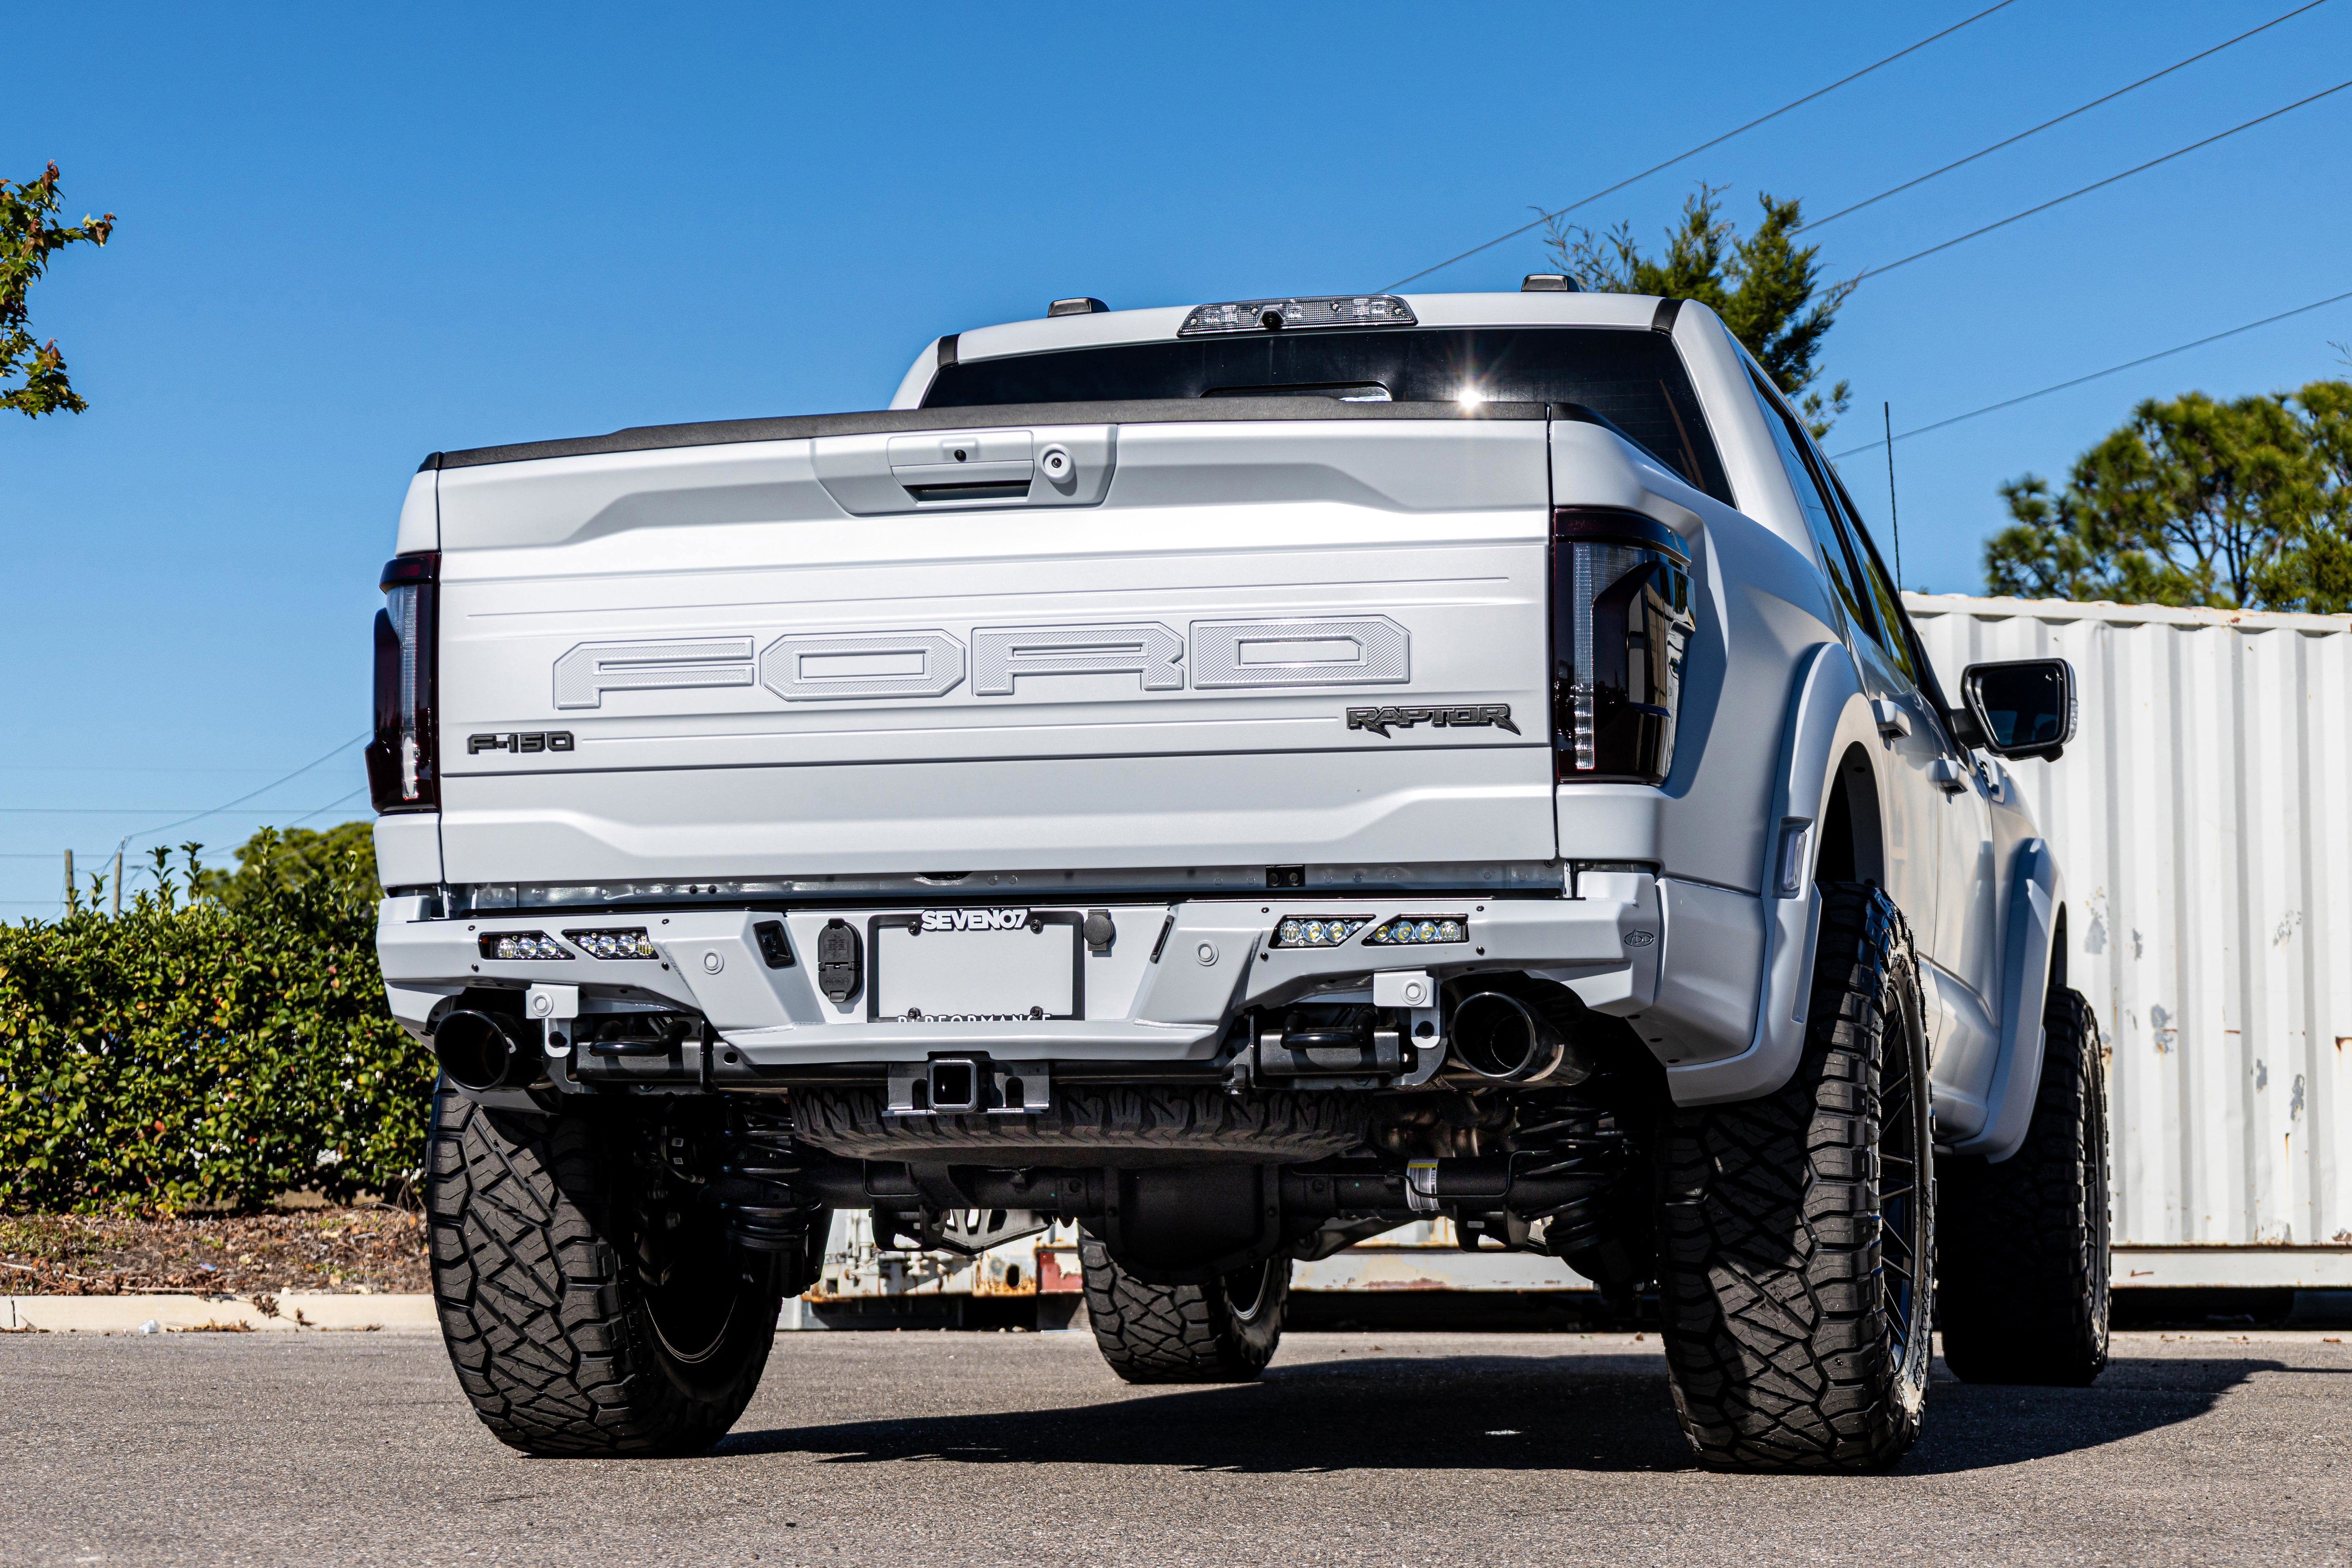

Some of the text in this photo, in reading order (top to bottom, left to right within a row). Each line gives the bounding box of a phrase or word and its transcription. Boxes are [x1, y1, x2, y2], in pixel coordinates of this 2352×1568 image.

[554, 614, 1412, 710] FORD
[1346, 703, 1521, 739] RAPTOR
[467, 731, 575, 755] F-150
[1629, 928, 1652, 945] ADD
